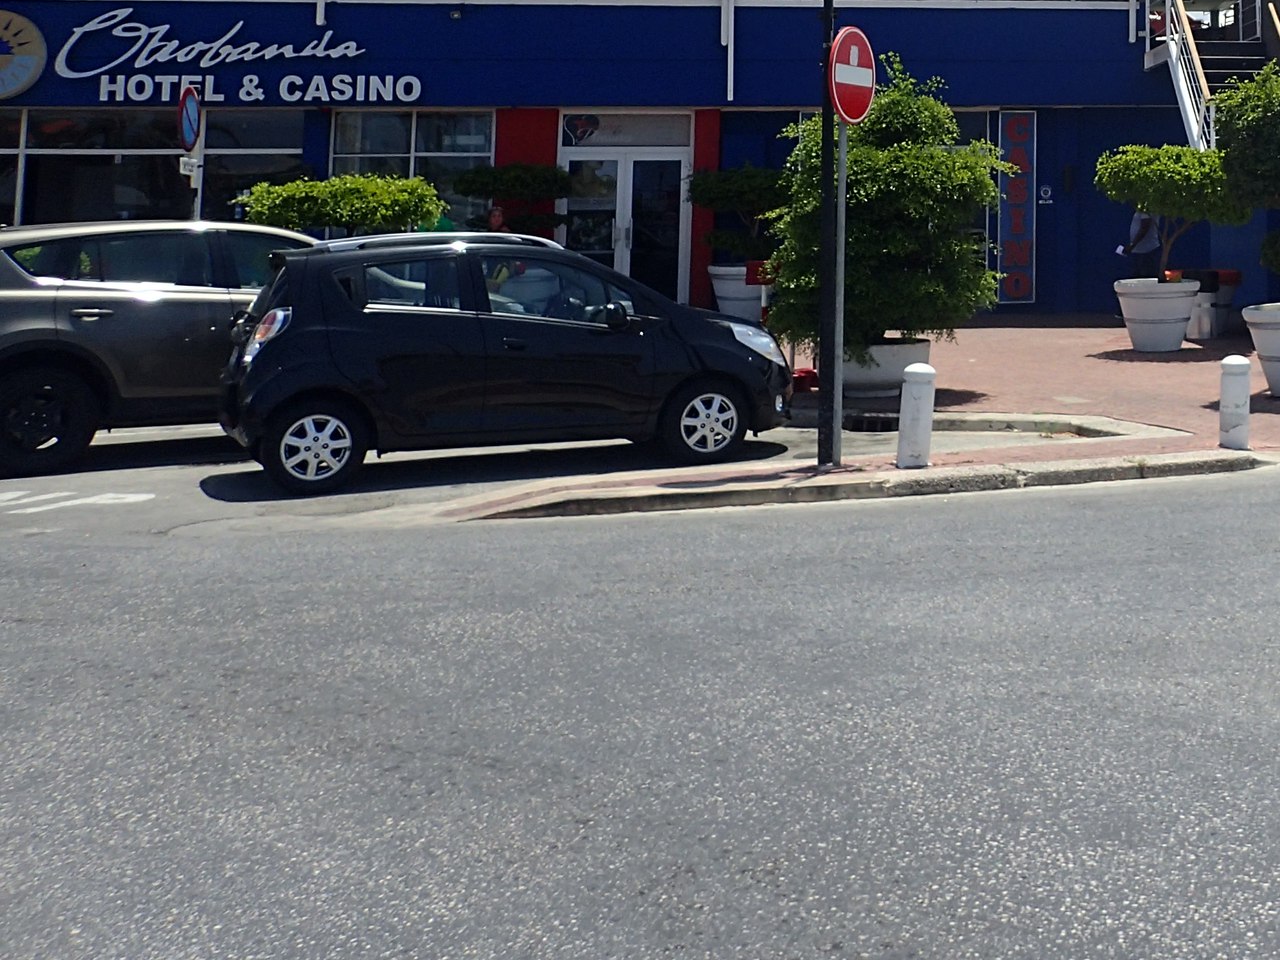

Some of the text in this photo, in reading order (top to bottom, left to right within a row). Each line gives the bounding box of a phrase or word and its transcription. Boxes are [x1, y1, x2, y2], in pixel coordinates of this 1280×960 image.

[54, 7, 366, 79] Otrobanda
[98, 74, 422, 102] HOTEL & CASINO
[1004, 116, 1031, 298] CASINO
